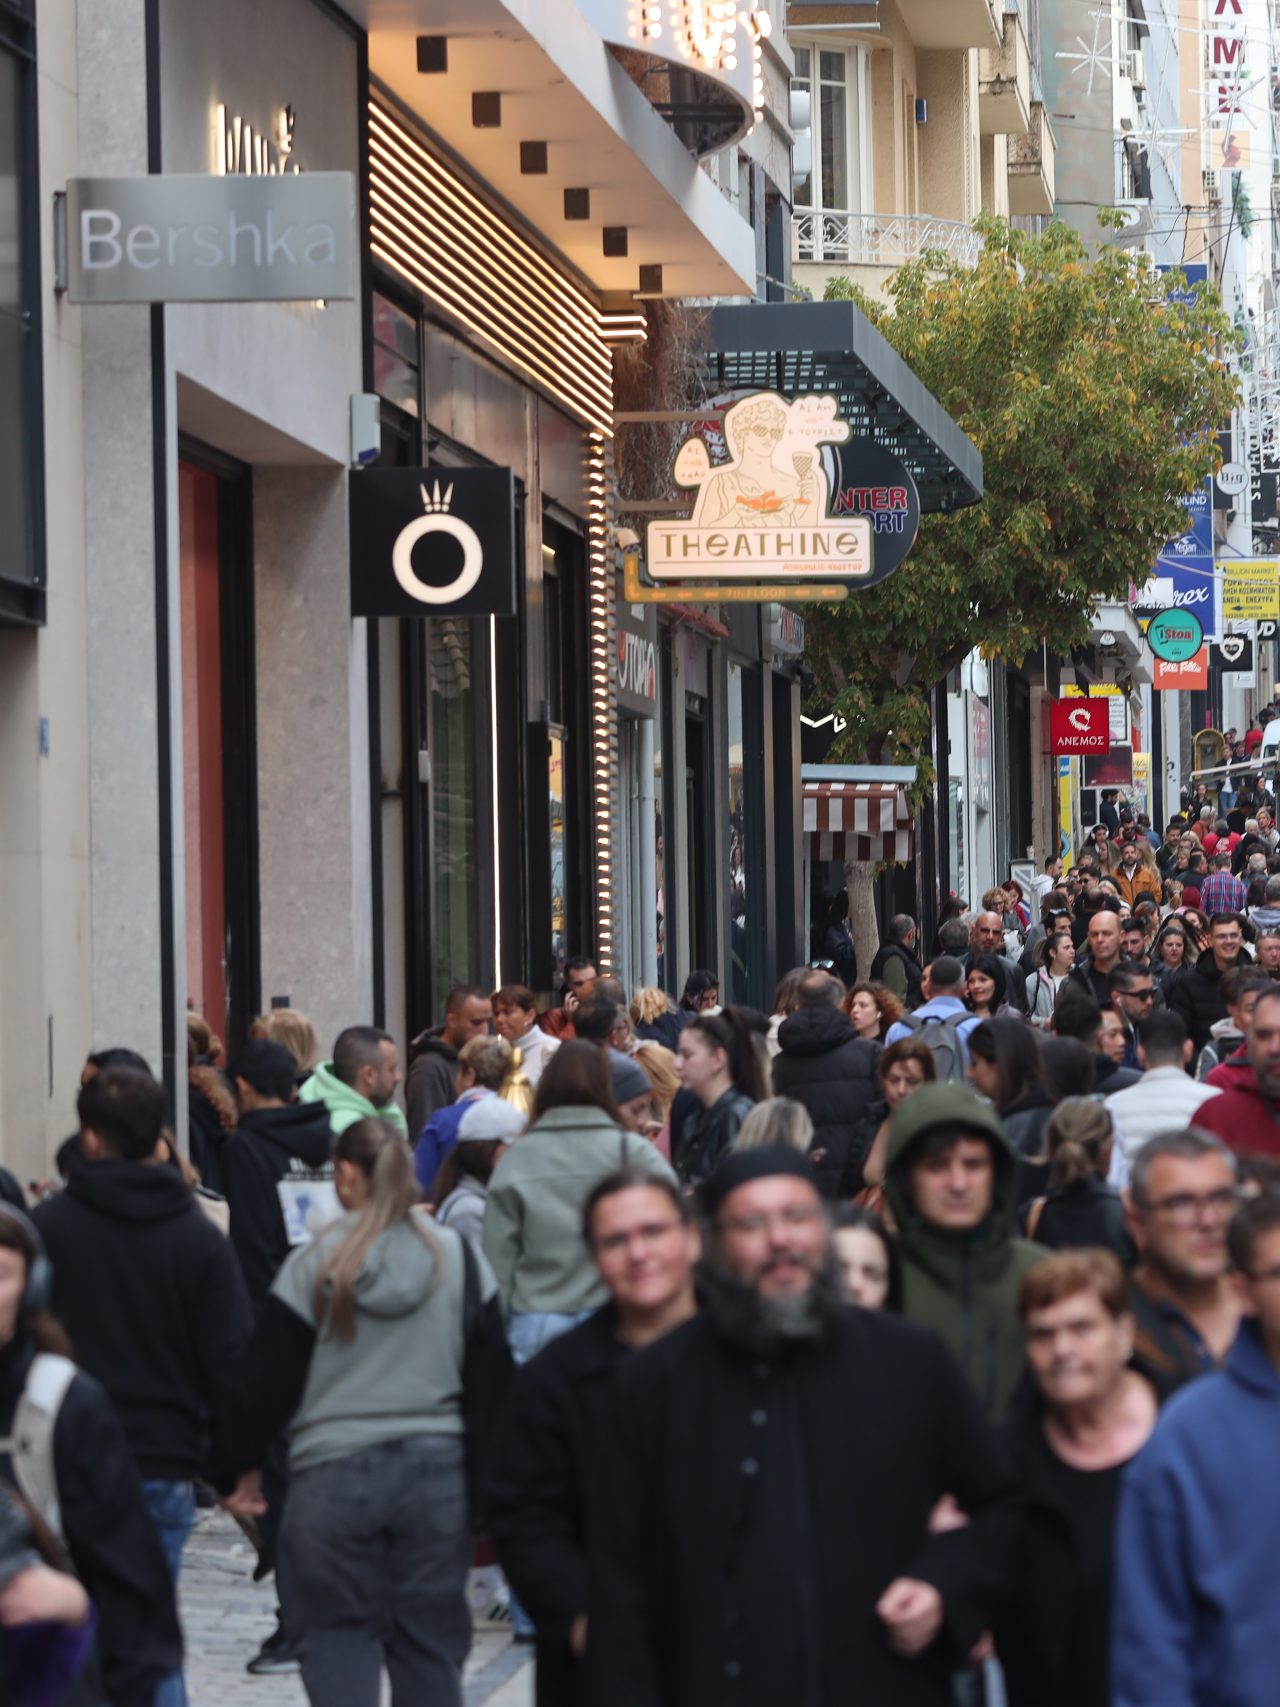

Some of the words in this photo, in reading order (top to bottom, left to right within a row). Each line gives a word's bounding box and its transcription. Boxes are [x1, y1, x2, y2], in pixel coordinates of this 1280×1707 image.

[81, 208, 337, 270] Bershka
[1221, 472, 1244, 485] Big
[836, 487, 908, 511] NTER
[1223, 578, 1244, 586] ΓΟΡΑ
[1173, 586, 1210, 607] rex
[1057, 735, 1105, 747] ΑΝΕΜΟΣ
